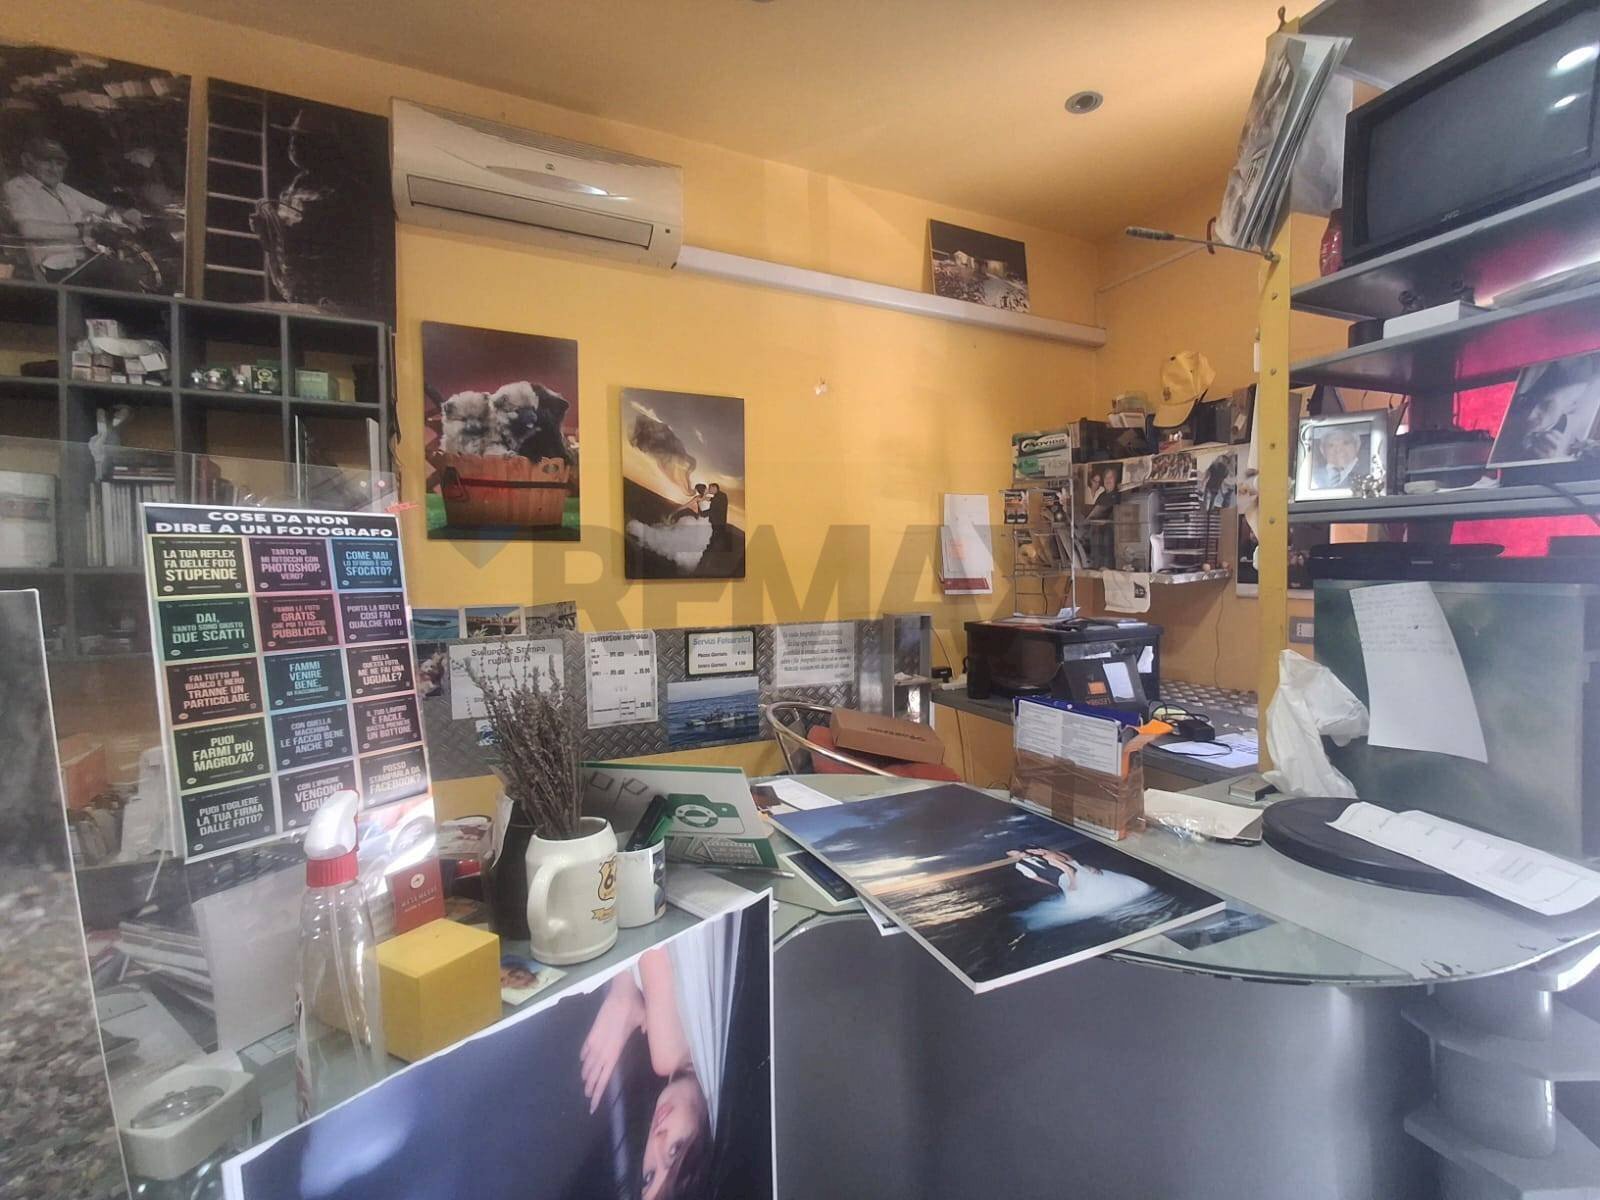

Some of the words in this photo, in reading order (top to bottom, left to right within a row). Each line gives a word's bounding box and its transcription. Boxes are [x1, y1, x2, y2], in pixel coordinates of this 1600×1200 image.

[208, 512, 266, 522] COSE
[272, 514, 302, 524] DA
[307, 515, 349, 525] NON
[156, 522, 212, 533] DIRE
[216, 524, 235, 533] A
[240, 525, 272, 534] UN
[277, 526, 393, 537] FOTOGRAFO
[163, 550, 177, 559] LA
[179, 549, 199, 558] TUA
[200, 549, 235, 558] REFLEX
[345, 551, 371, 560] COME
[372, 551, 389, 560] MAI
[164, 559, 178, 569] FA
[180, 559, 209, 568] DELLE
[212, 559, 236, 567] FOTO
[165, 568, 238, 582] STUPENDE
[346, 566, 392, 576] SFOCATO?
[378, 604, 400, 612] REFLEX
[281, 612, 316, 622] GRATIS
[379, 611, 391, 619] FAI
[172, 624, 197, 632] TANTO
[198, 623, 218, 631] SONO
[271, 622, 285, 630] CHE
[349, 619, 383, 630] QUALCHE
[384, 618, 402, 626] FOTO
[172, 631, 198, 644] DUE
[202, 629, 245, 642] SCATTI
[289, 660, 320, 673] FAMMI
[358, 668, 368, 677] ME
[369, 667, 379, 675] NE
[380, 666, 391, 674] FAI
[188, 674, 202, 682] FAI
[204, 672, 230, 680] TUTTO
[289, 669, 322, 681] VENIRE
[363, 673, 402, 686] UGUALE?
[184, 680, 216, 691] BIANCO
[224, 677, 245, 686] NERO
[188, 687, 229, 700] TRANNE
[230, 684, 244, 694] UN
[183, 692, 251, 709] PARTICOLARE
[291, 722, 305, 731] CON
[367, 732, 378, 740] UN
[380, 726, 412, 738] BOTTONE
[210, 734, 235, 747] PUOI
[280, 739, 290, 748] LE
[293, 734, 322, 746] FACCIO
[324, 729, 344, 740] BENE
[192, 746, 231, 761] FARMI
[234, 740, 254, 754] PIÙ
[295, 741, 322, 754] ANCHE
[194, 752, 255, 772] MAGRO/A?
[382, 761, 406, 774] POSSO
[296, 782, 311, 792] CON
[199, 805, 220, 817] PUOI
[221, 796, 259, 811] TOGLIERE
[196, 815, 212, 827] LA
[212, 811, 232, 824] TUA
[234, 804, 264, 818] FIRMA
[200, 823, 231, 837] DALLE
[233, 813, 263, 828] FOTO?
